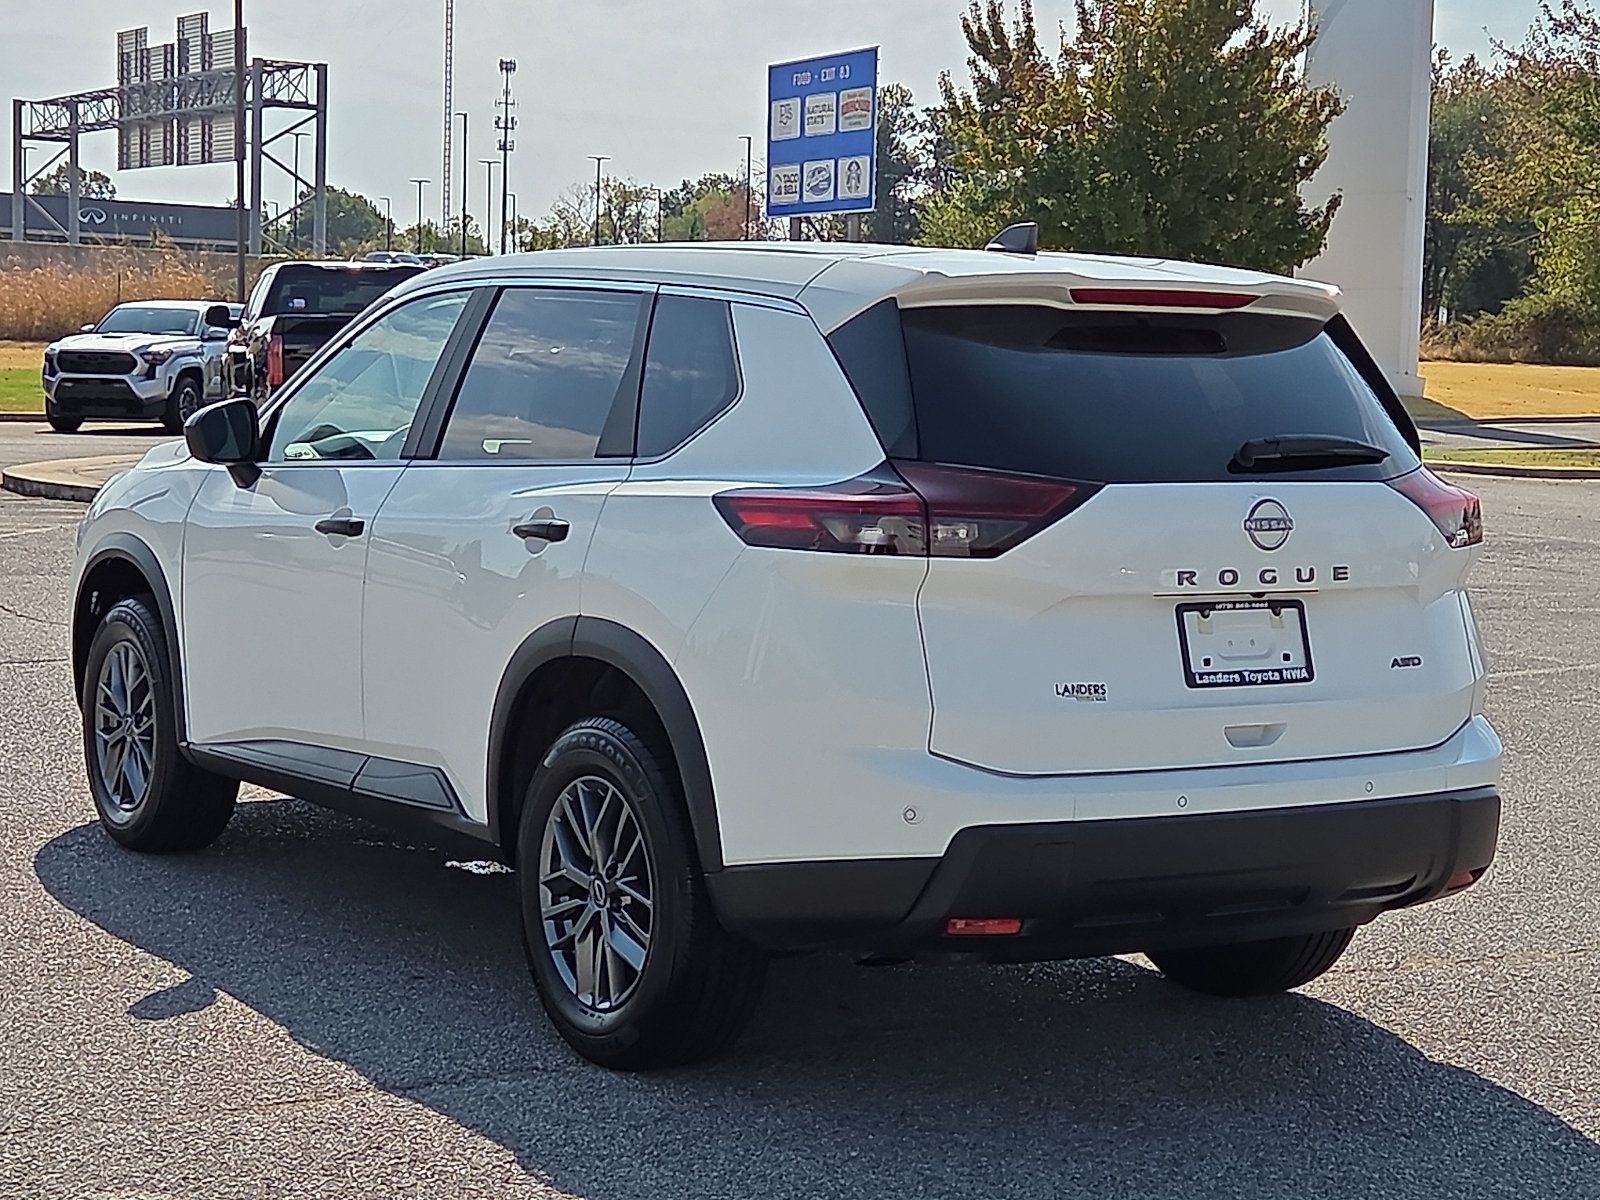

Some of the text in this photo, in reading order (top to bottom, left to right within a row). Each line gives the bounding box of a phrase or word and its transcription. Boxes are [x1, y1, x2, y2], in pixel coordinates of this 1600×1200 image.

[113, 213, 183, 225] INFINITI
[1245, 519, 1293, 531] NISSAN
[1177, 566, 1350, 586] ROGUE
[1195, 668, 1309, 684] Landers Toyota NWA
[1055, 683, 1107, 697] LANDERS
